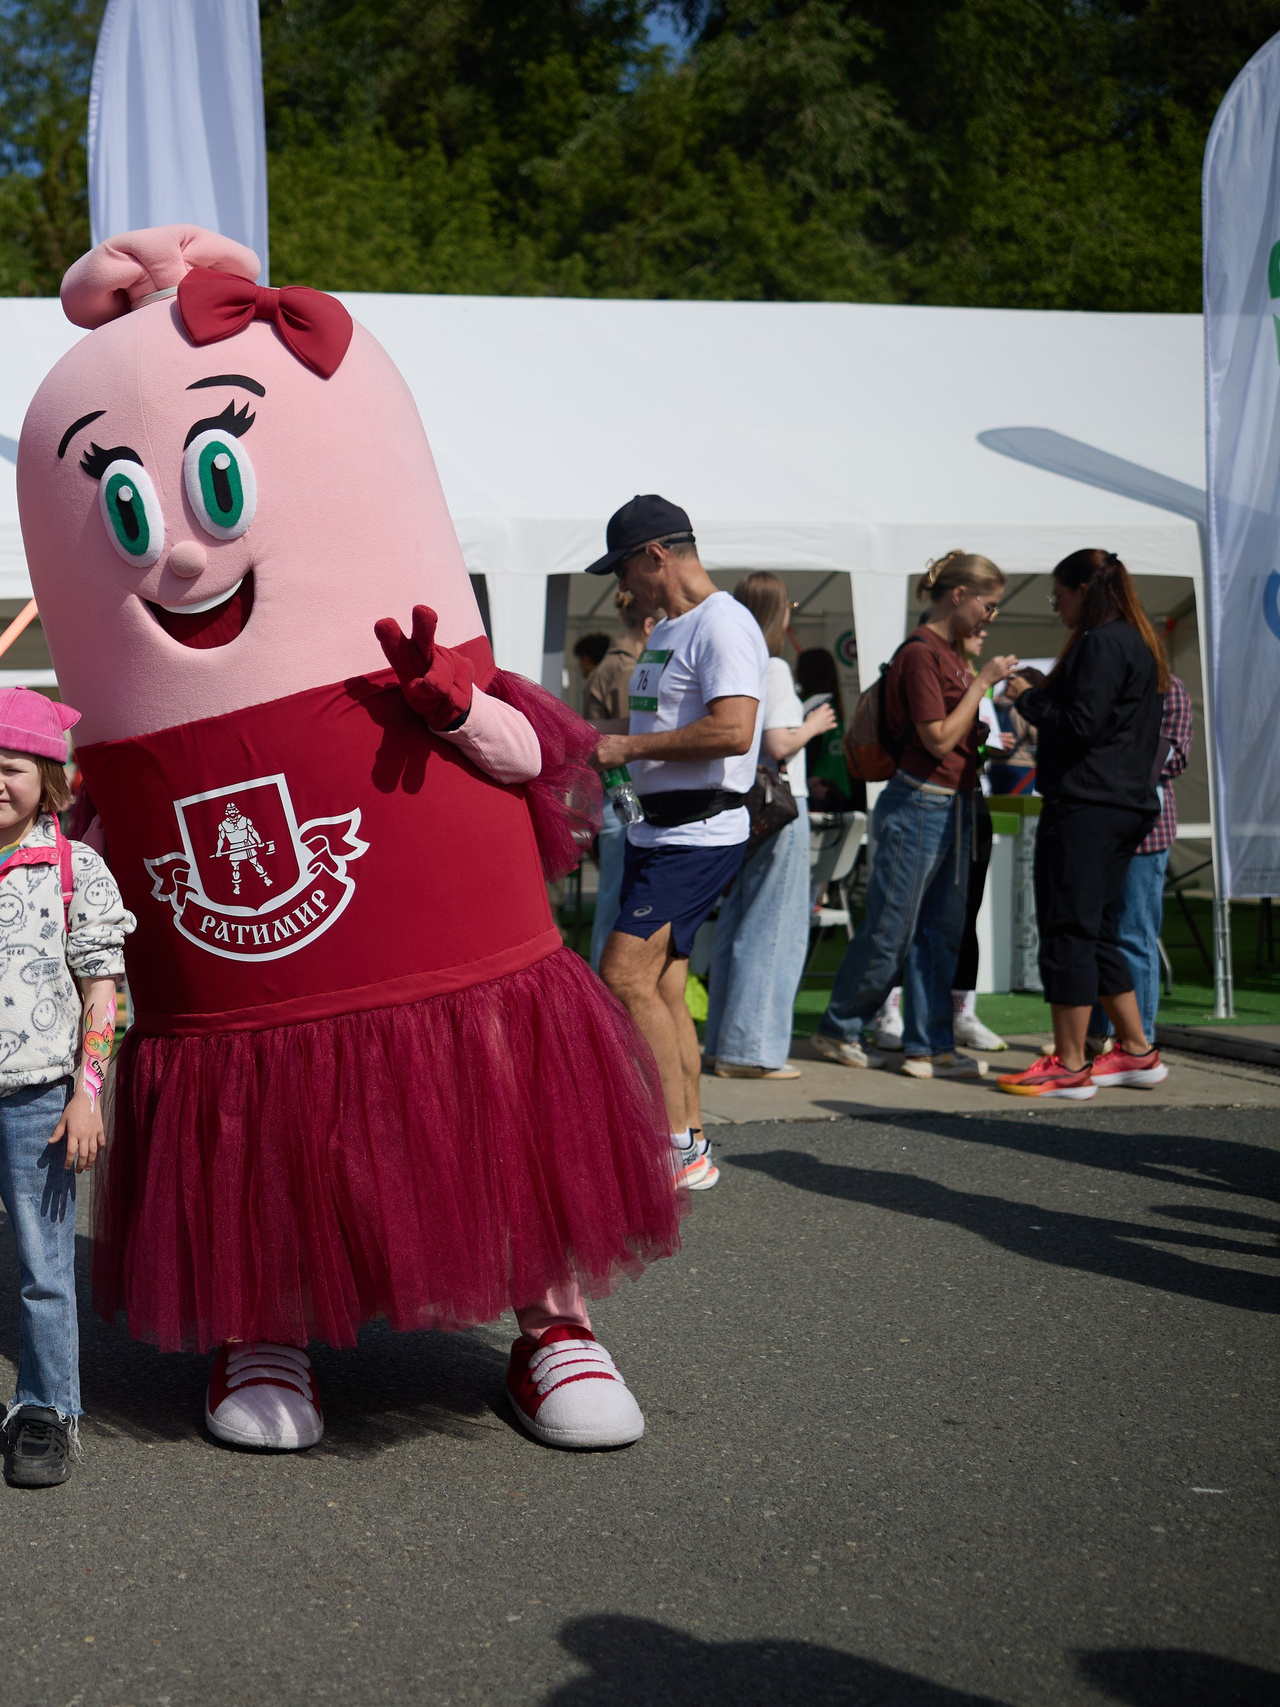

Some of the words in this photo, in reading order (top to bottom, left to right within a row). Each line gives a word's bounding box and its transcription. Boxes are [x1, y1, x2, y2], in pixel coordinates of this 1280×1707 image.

[637, 669, 650, 691] 76
[198, 888, 330, 946] РАТИМИР
[6, 948, 25, 956] HERE
